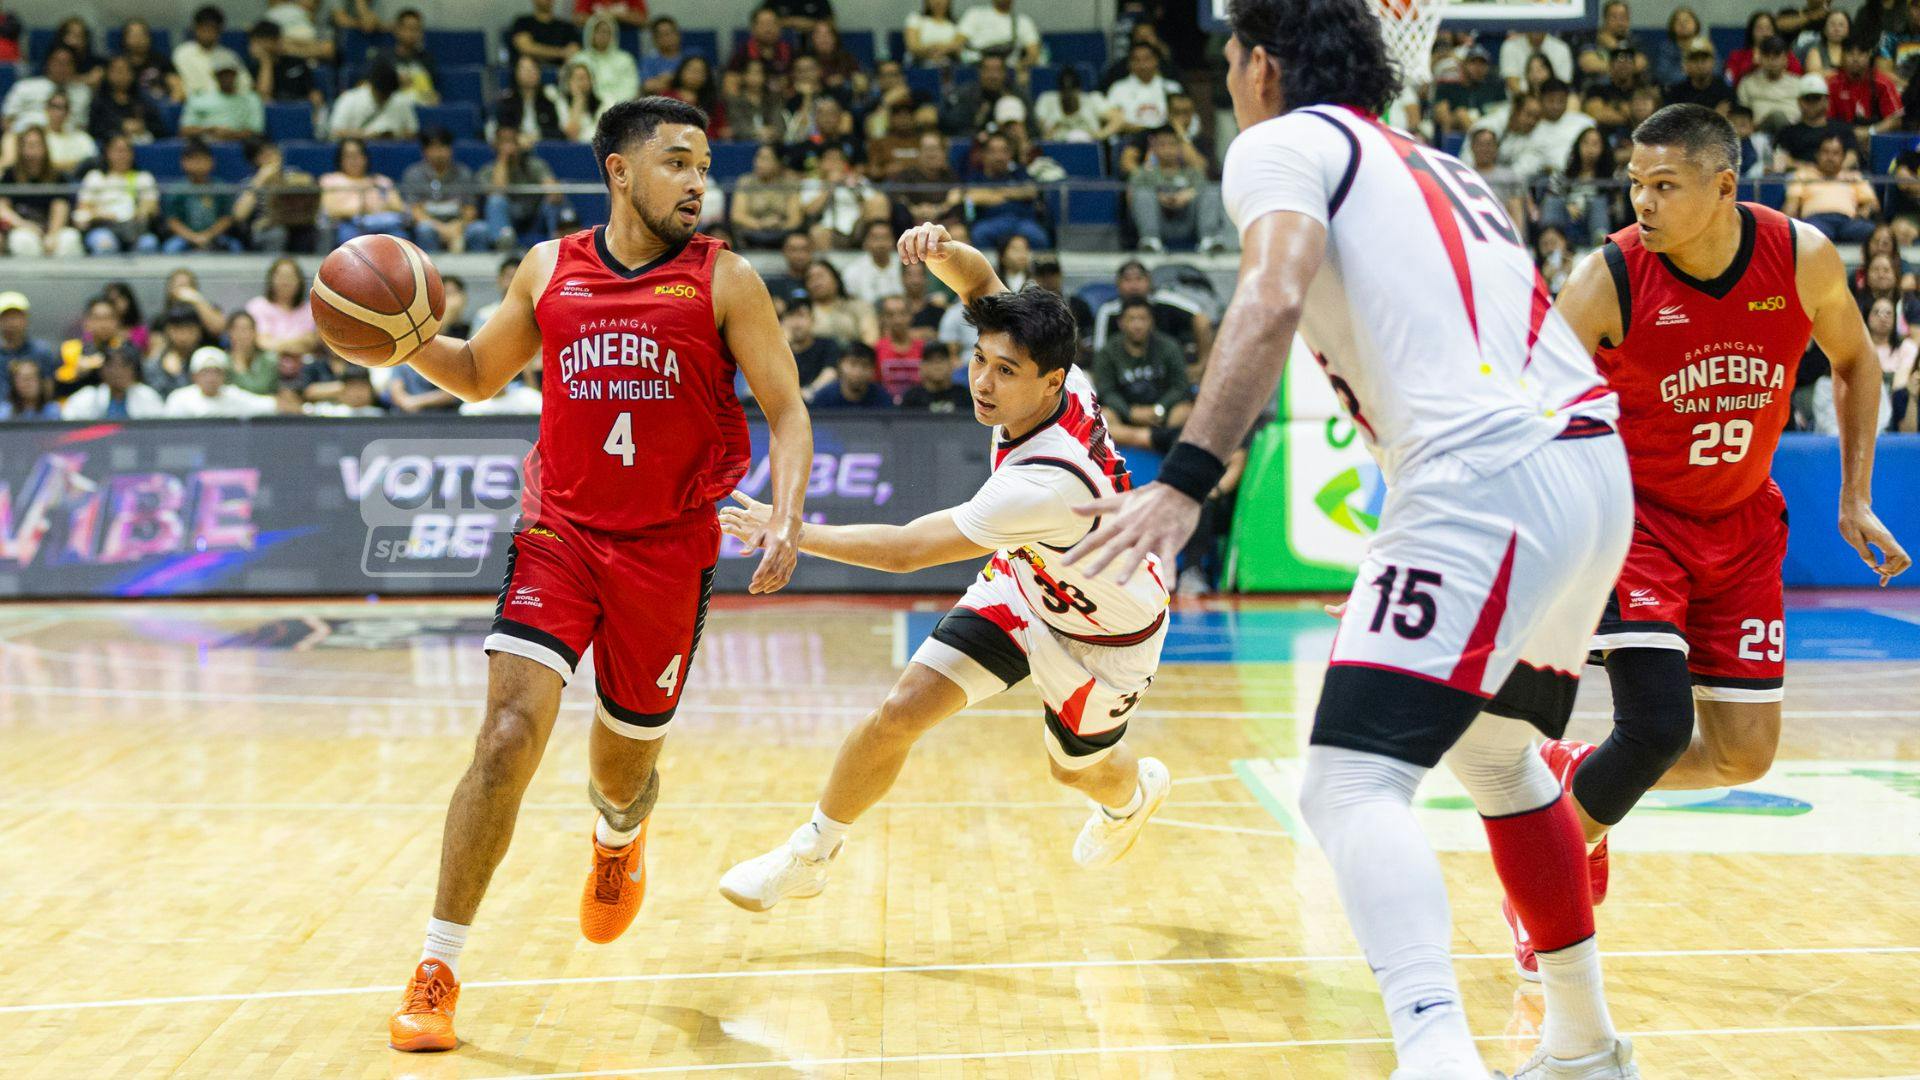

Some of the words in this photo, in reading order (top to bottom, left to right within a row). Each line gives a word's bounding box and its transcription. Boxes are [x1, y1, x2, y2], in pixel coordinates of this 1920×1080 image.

[1402, 150, 1524, 247] 15
[580, 318, 658, 334] BARANGAY
[559, 332, 681, 385] GINEBRA
[1685, 341, 1764, 361] BARANGAY
[568, 379, 602, 400] SAN
[608, 379, 675, 400] MIGUEL
[1659, 355, 1786, 403] GINEBRA
[1672, 397, 1710, 414] SAN
[1715, 391, 1773, 413] MIGUEL
[602, 411, 637, 467] 4
[1688, 418, 1754, 466] 29
[339, 455, 518, 502] VOTE
[1032, 572, 1099, 615] 33
[1368, 565, 1443, 641] 15
[1738, 618, 1784, 663] 29
[655, 654, 683, 697] 4
